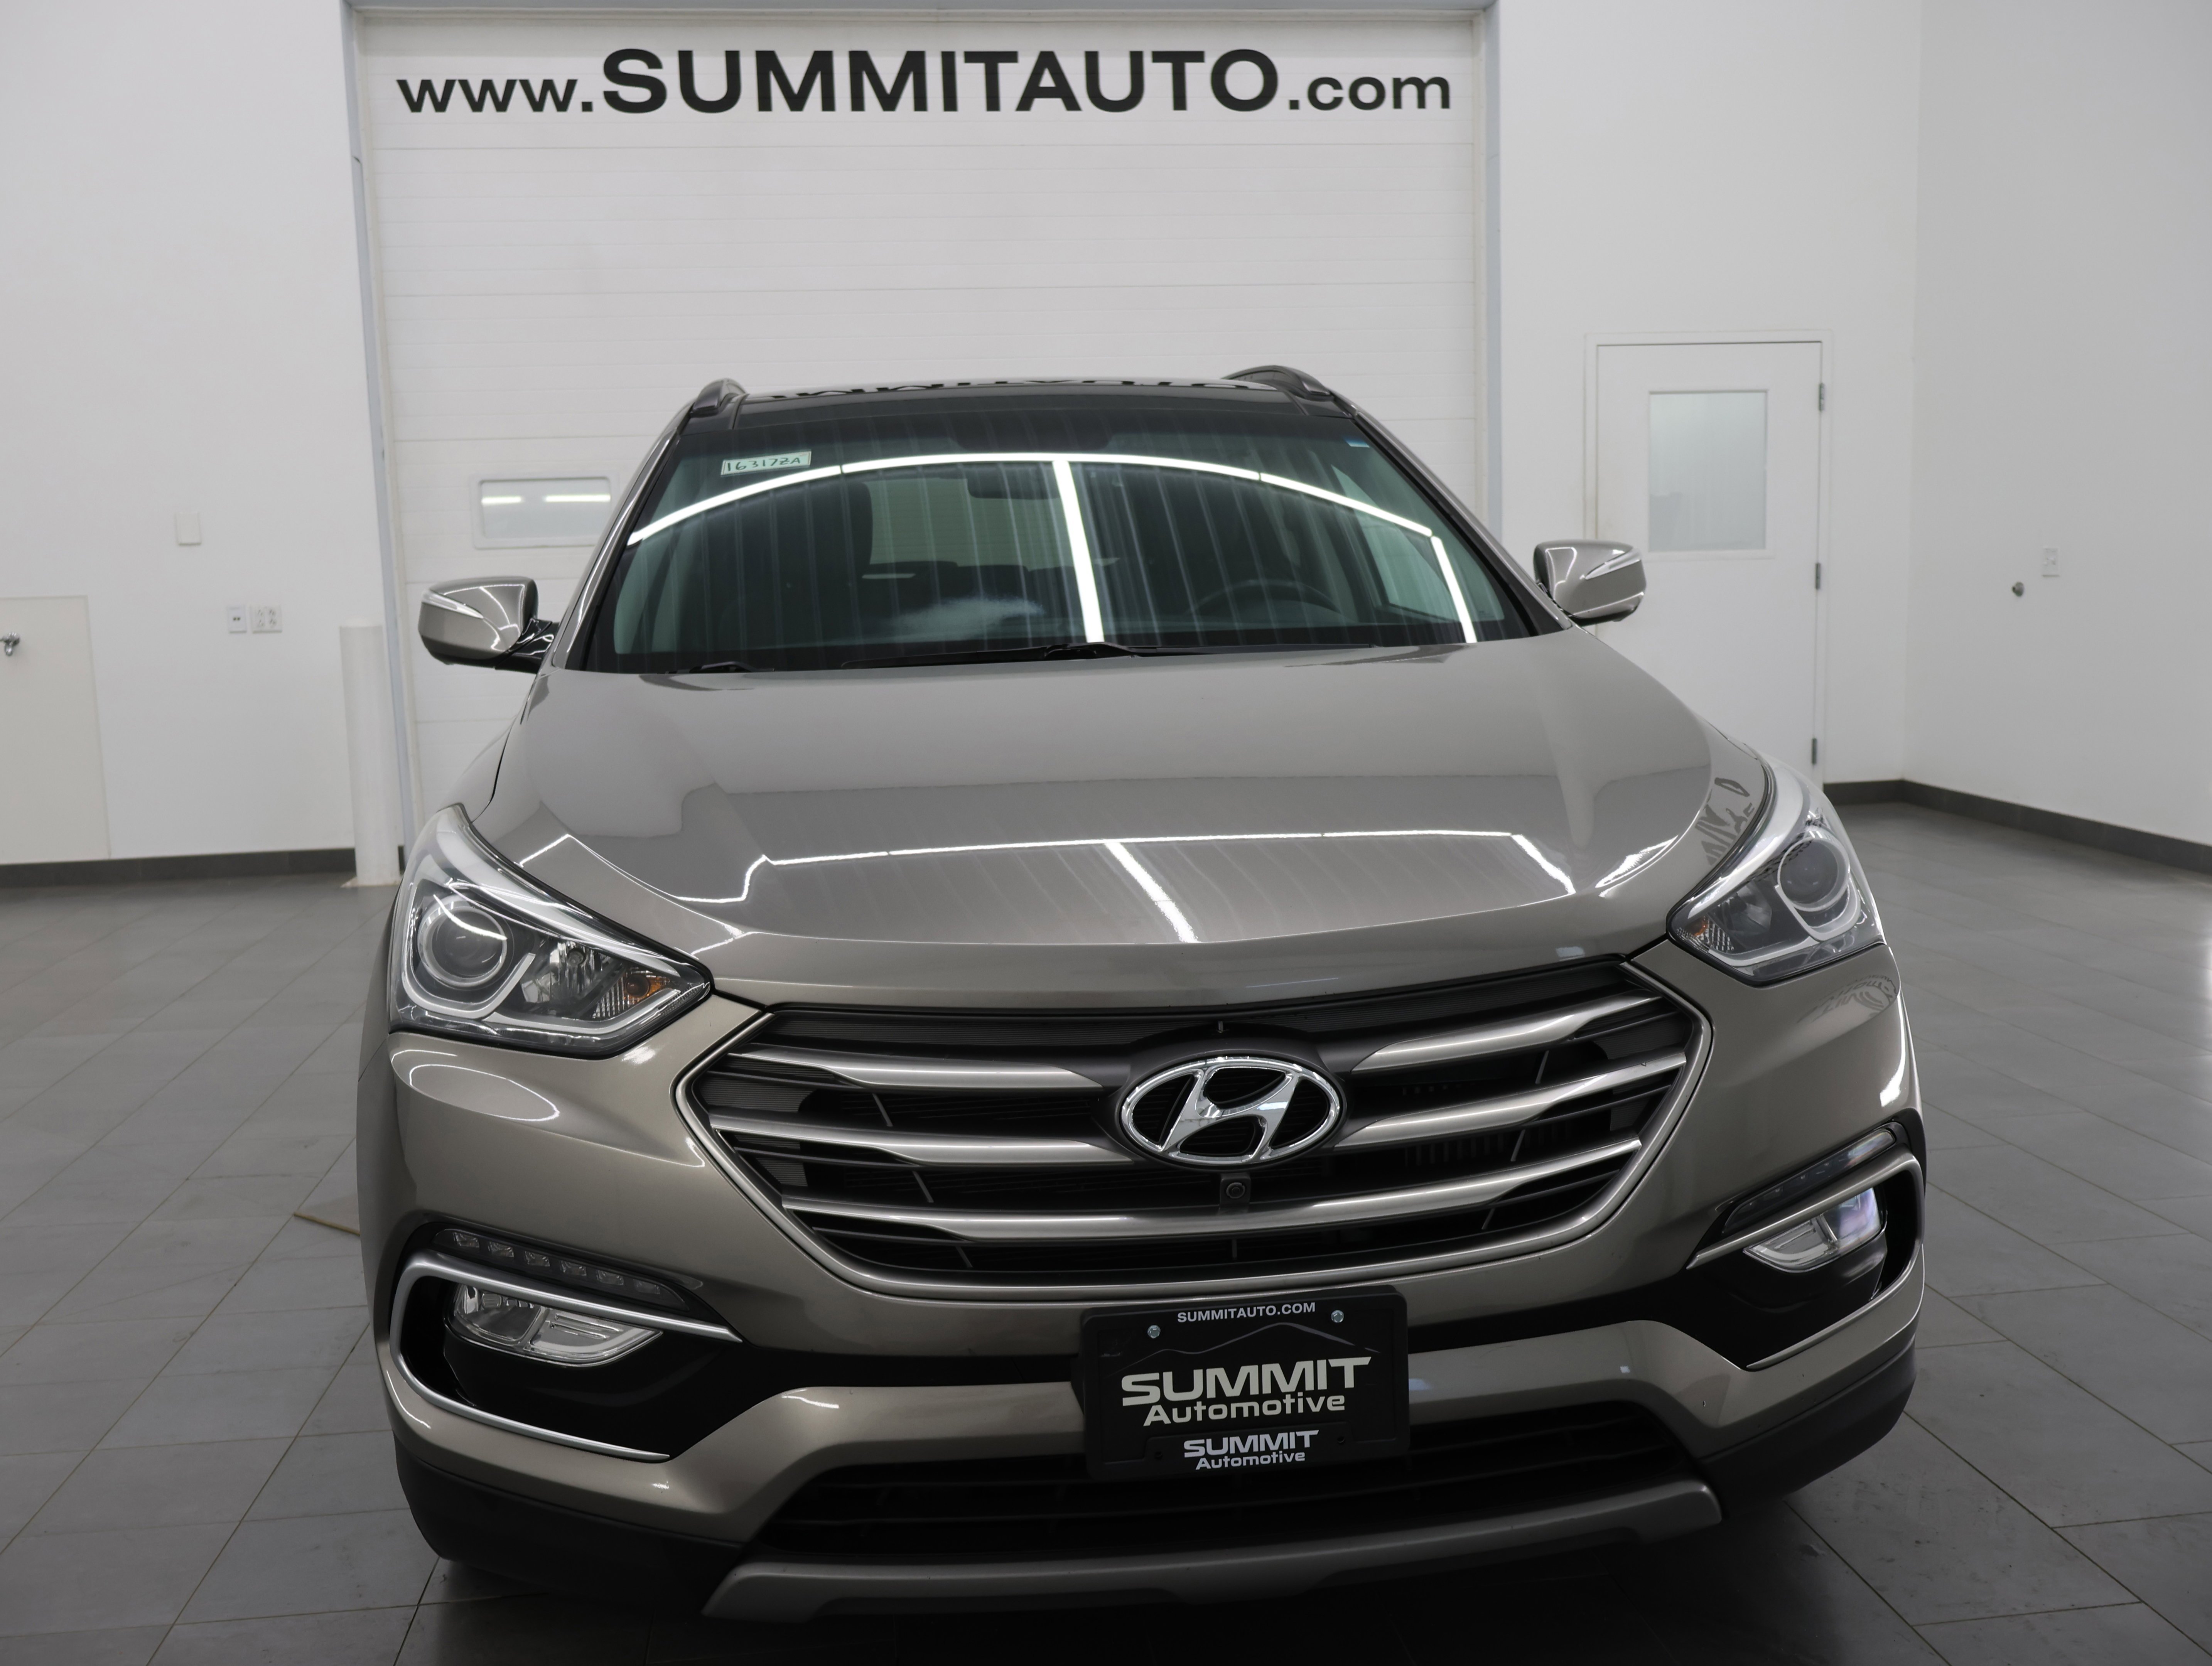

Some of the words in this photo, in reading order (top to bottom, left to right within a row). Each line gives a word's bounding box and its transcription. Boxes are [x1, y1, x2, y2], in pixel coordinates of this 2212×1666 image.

[396, 48, 1451, 114] www.SUMMITAUTO.com
[1177, 1302, 1316, 1323] SUMMITAUTO.COM
[1121, 1356, 1372, 1407] SUMMIT
[1143, 1391, 1345, 1427] Automotive
[1183, 1429, 1319, 1458] SUMMIT
[1195, 1451, 1306, 1470] Automotive
